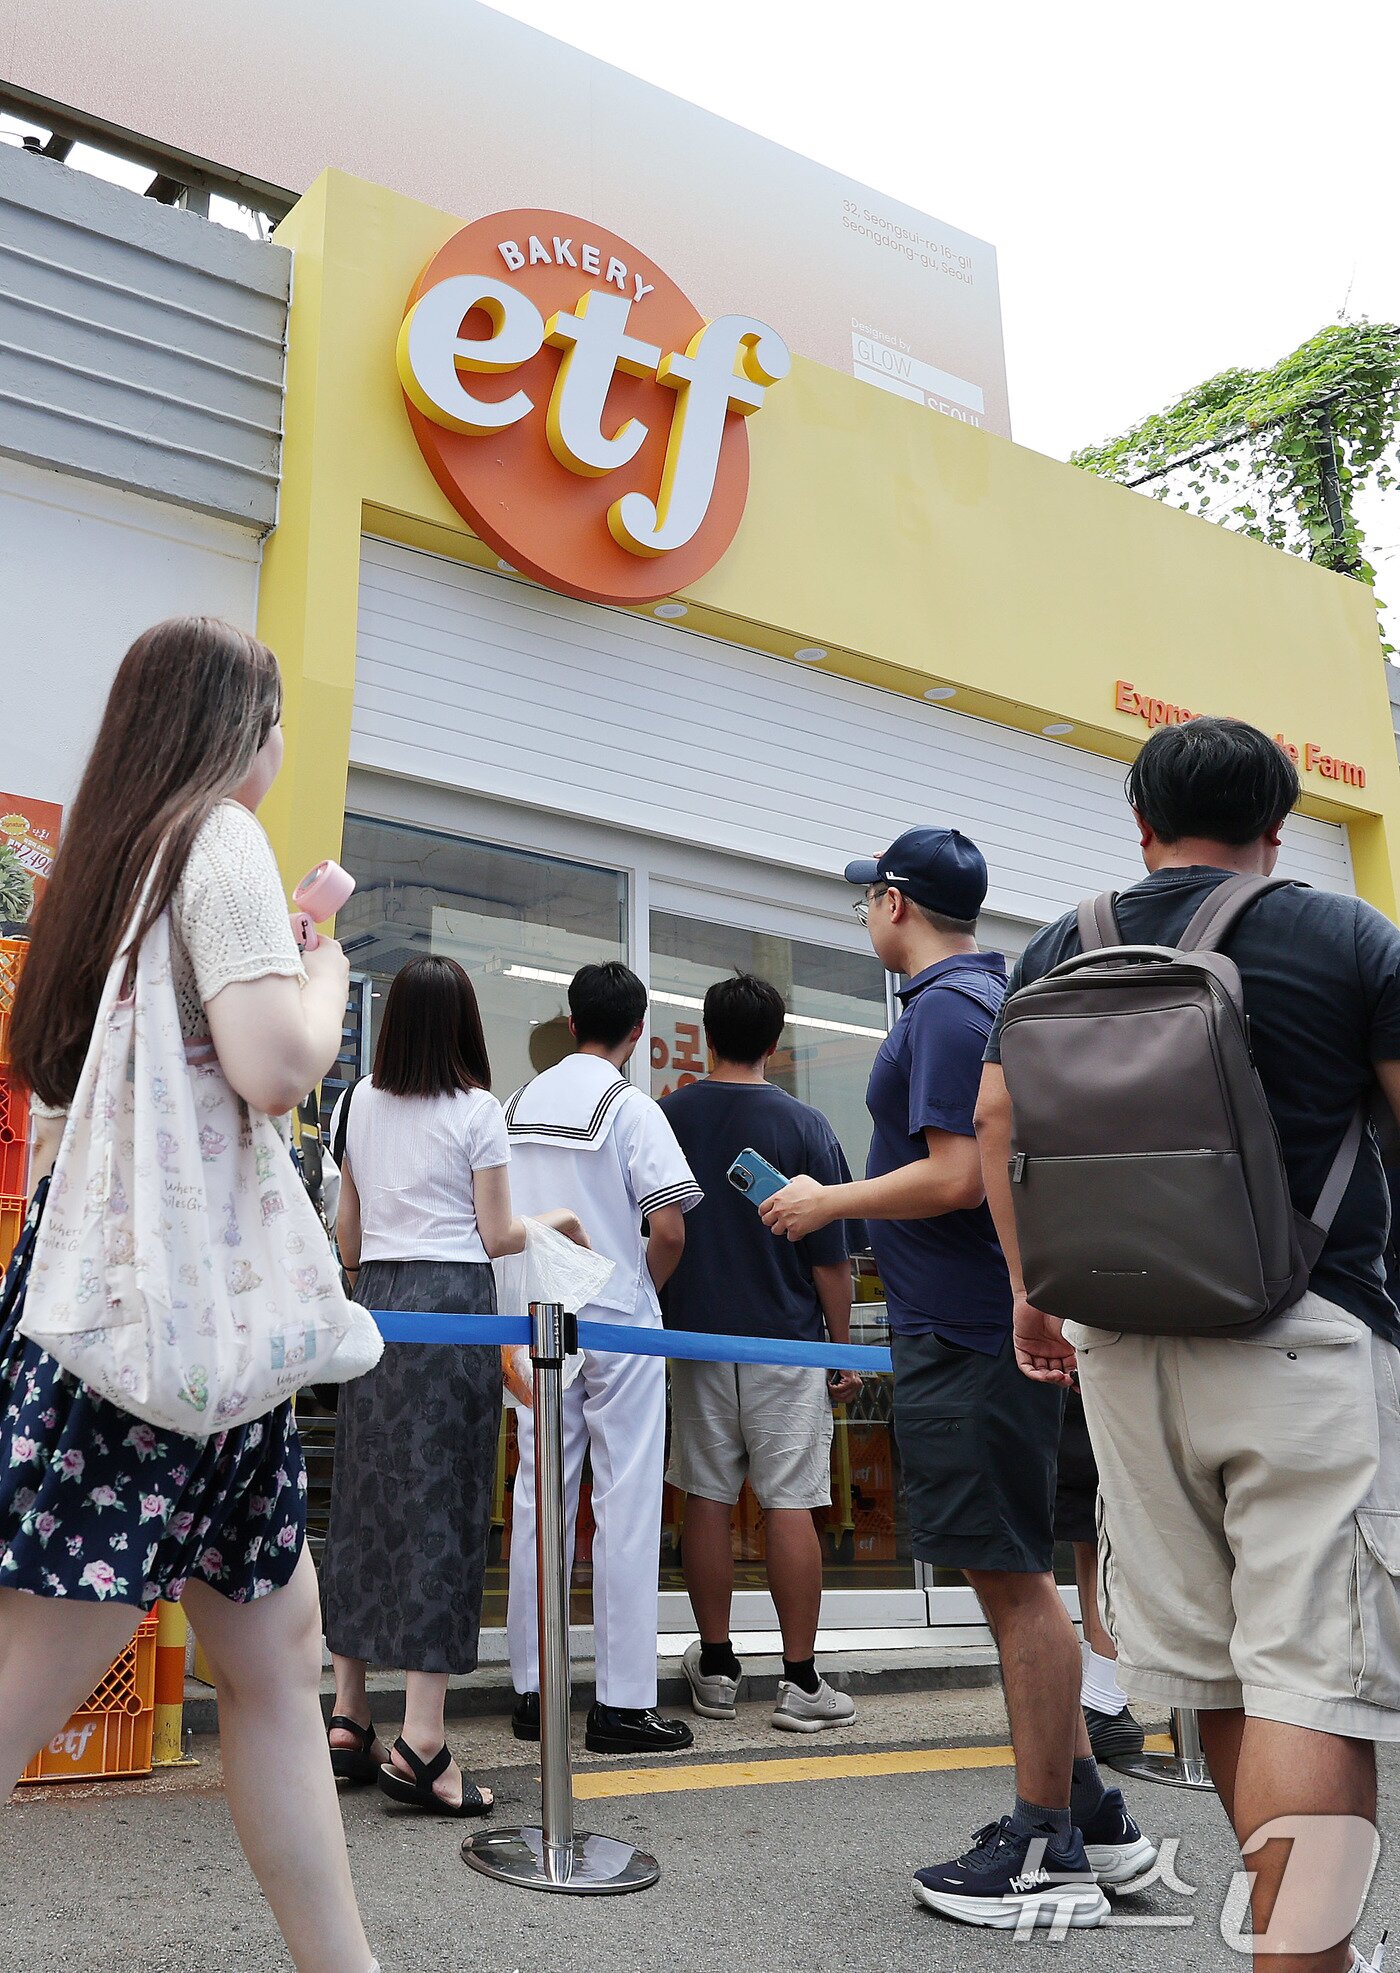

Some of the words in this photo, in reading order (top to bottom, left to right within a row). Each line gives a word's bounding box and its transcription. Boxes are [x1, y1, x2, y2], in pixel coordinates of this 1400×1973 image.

[842, 216, 939, 271] Seongdong-gu,
[941, 262, 974, 285] Seoul
[843, 200, 861, 218] 32,
[864, 210, 938, 253] Seongsui-ro
[941, 245, 972, 269] 16-gil
[498, 235, 655, 303] BAKERY
[851, 317, 897, 345] Designed
[899, 338, 911, 353] by
[857, 339, 912, 378] GLOW
[396, 274, 792, 558] etf
[1115, 680, 1203, 728] Expre
[1305, 743, 1366, 788] Farm
[165, 1179, 203, 1196] Where
[49, 1722, 97, 1761] etf
[1009, 1866, 1051, 1893] HOKA
